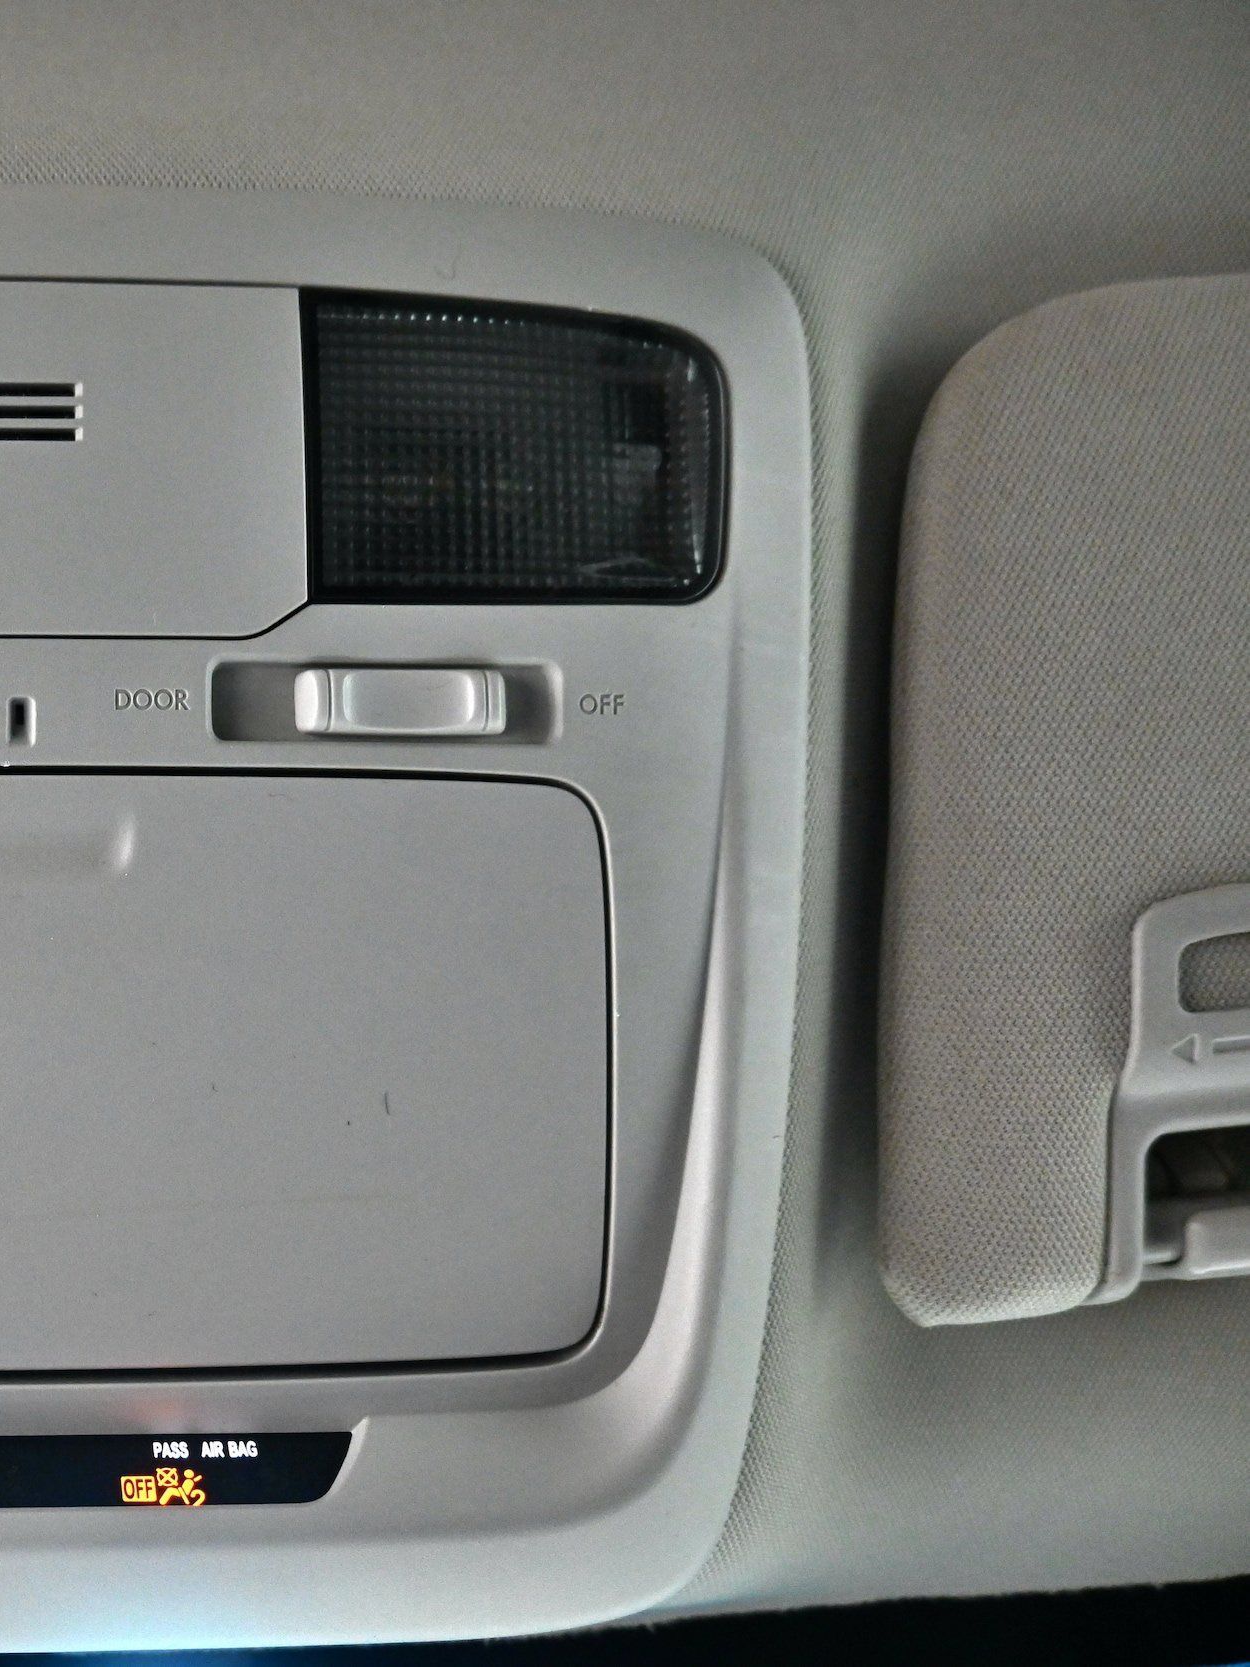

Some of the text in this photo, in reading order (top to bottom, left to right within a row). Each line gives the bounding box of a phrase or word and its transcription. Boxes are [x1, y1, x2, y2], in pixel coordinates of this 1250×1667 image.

[113, 688, 191, 711] DOOR
[578, 693, 626, 716] OFF
[152, 1440, 259, 1459] PASS AIR BAG
[123, 1478, 154, 1500] OFF
